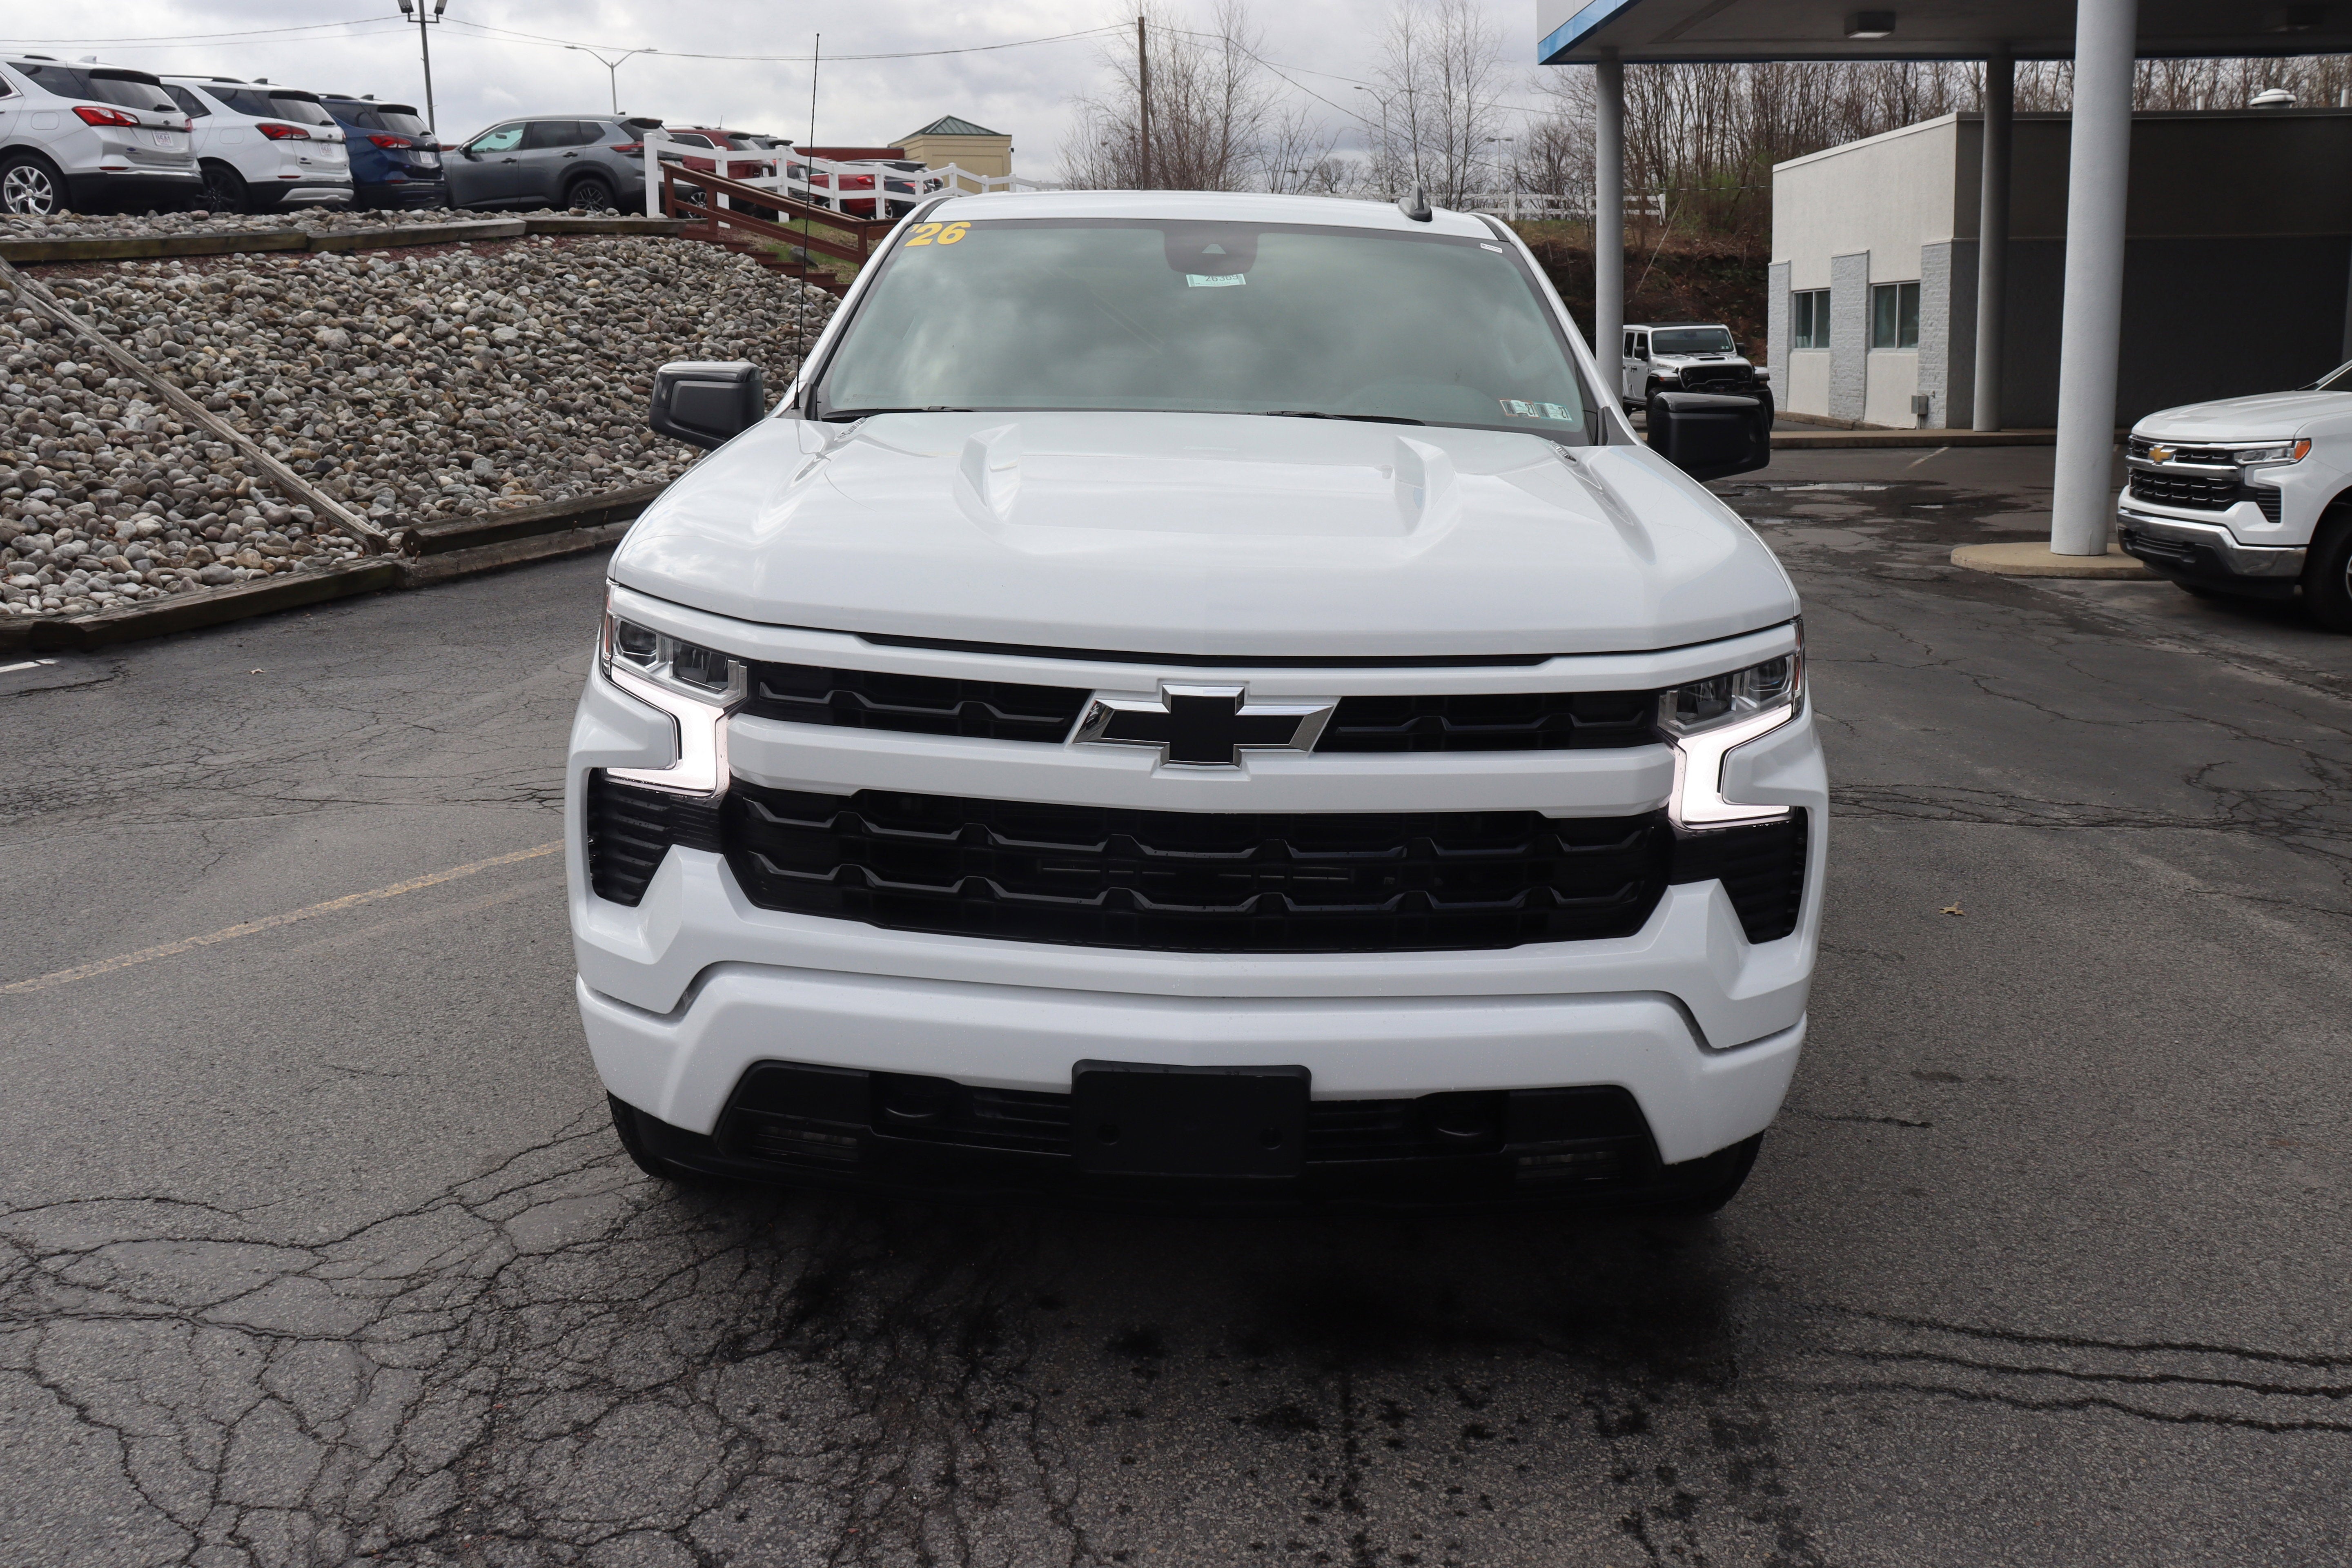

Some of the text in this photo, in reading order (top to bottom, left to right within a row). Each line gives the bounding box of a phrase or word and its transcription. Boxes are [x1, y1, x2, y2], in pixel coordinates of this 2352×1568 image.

[904, 221, 971, 247] '26
[1525, 403, 1535, 416] 27
[1558, 406, 1569, 419] 27
